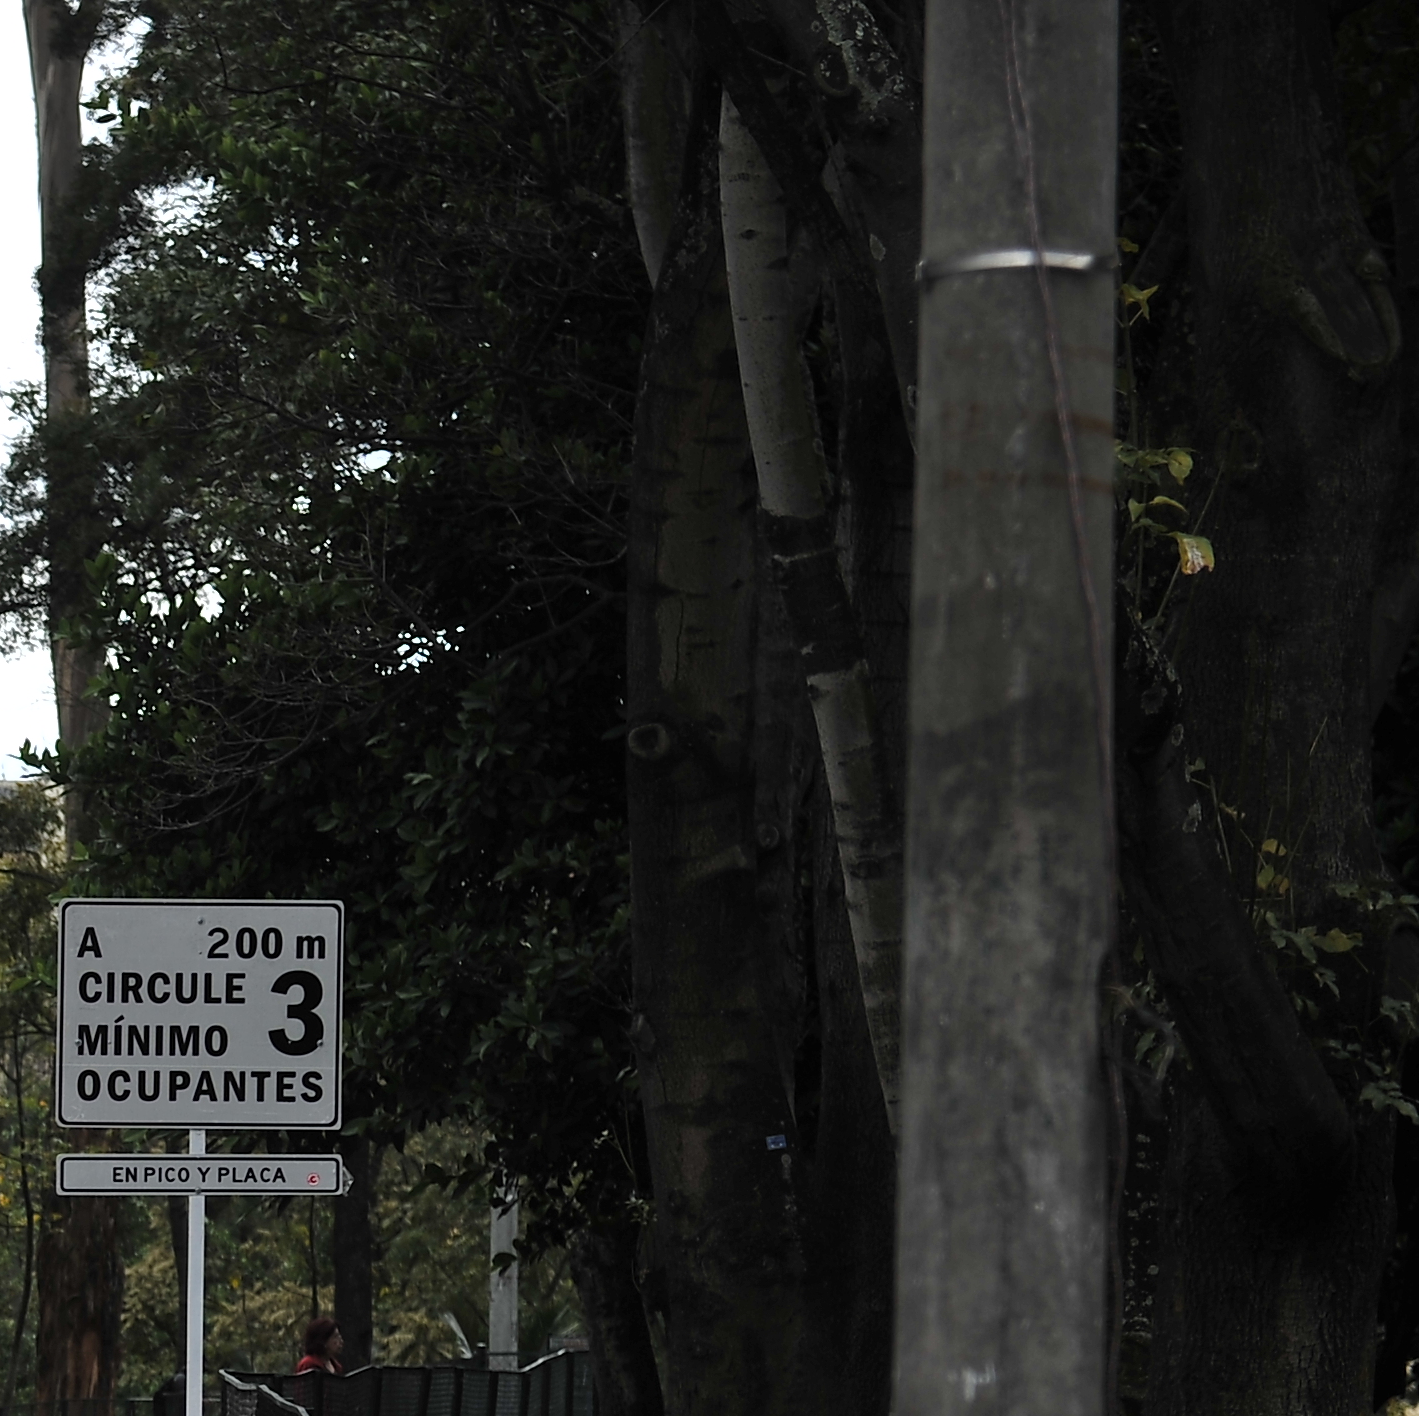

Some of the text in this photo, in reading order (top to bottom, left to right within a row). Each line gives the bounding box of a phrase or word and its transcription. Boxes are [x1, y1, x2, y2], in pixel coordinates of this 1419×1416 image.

[77, 926, 326, 959] A 200 m
[78, 971, 246, 1004] CIRCULE
[267, 969, 325, 1057] 3
[76, 1014, 229, 1057] MÍNIMO
[76, 1070, 324, 1102] OCUPANTES
[112, 1167, 286, 1183] EN PICO Y PLACA
